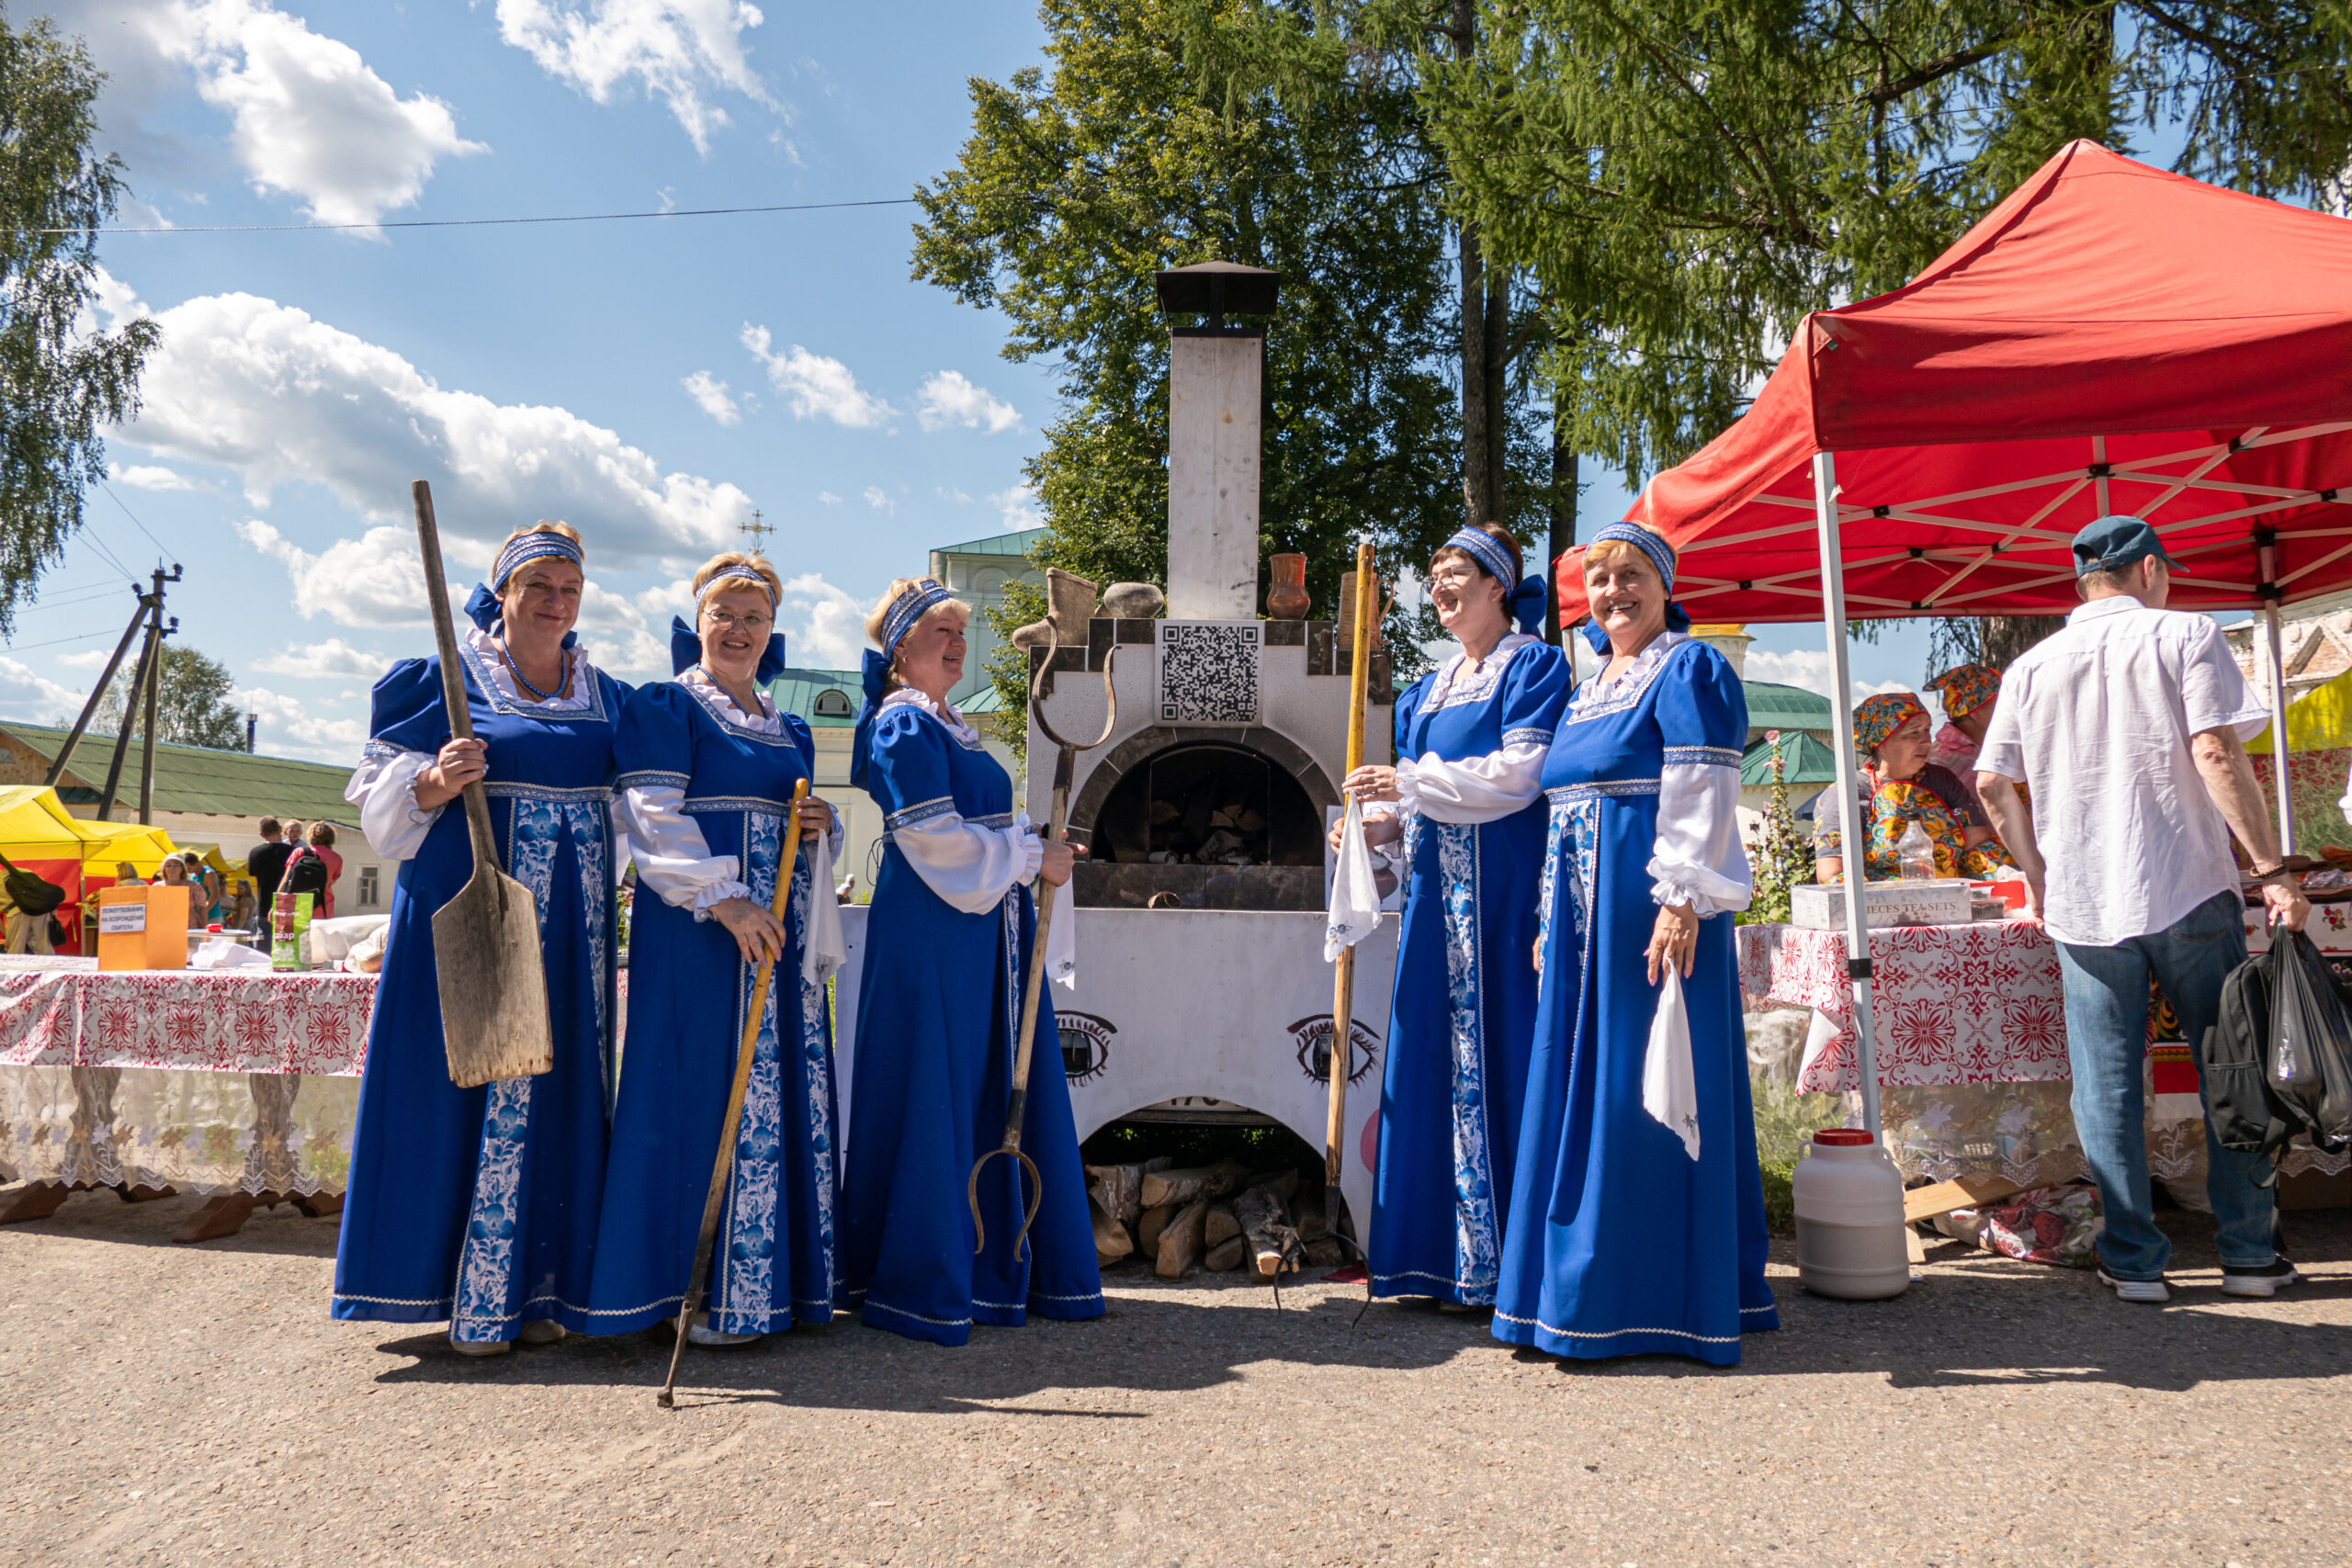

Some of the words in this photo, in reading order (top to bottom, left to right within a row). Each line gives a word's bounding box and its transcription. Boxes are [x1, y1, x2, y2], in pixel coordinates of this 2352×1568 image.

[1866, 904, 1900, 915] IECES
[1902, 903, 1926, 913] TEA
[1928, 901, 1956, 911] SETS
